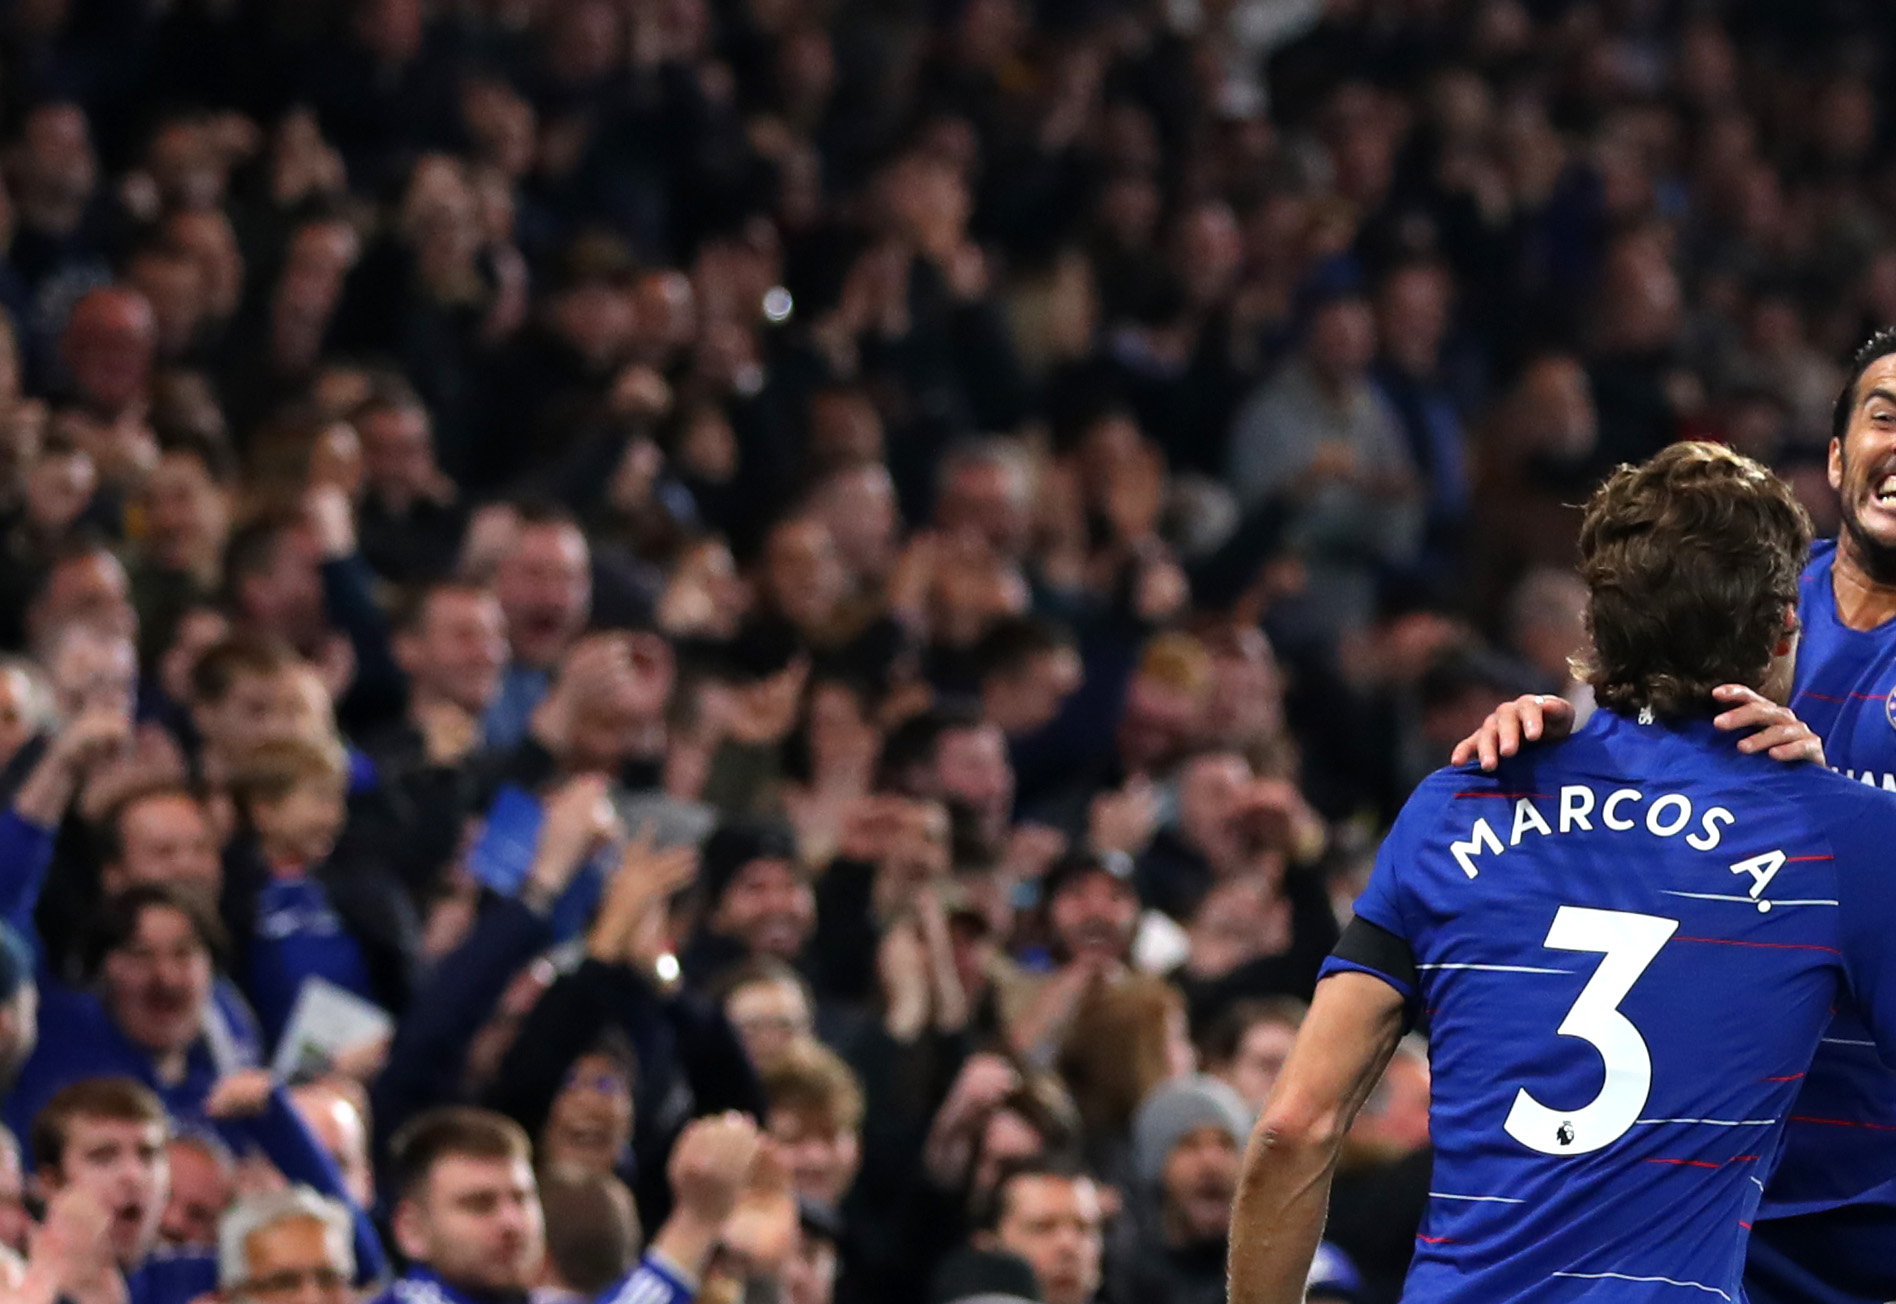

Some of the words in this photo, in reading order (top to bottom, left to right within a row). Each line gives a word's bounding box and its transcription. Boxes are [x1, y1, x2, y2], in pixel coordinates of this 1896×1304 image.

[1450, 784, 1735, 879] MARCOS
[1729, 850, 1787, 913] A.
[1503, 905, 1680, 1155] 3
